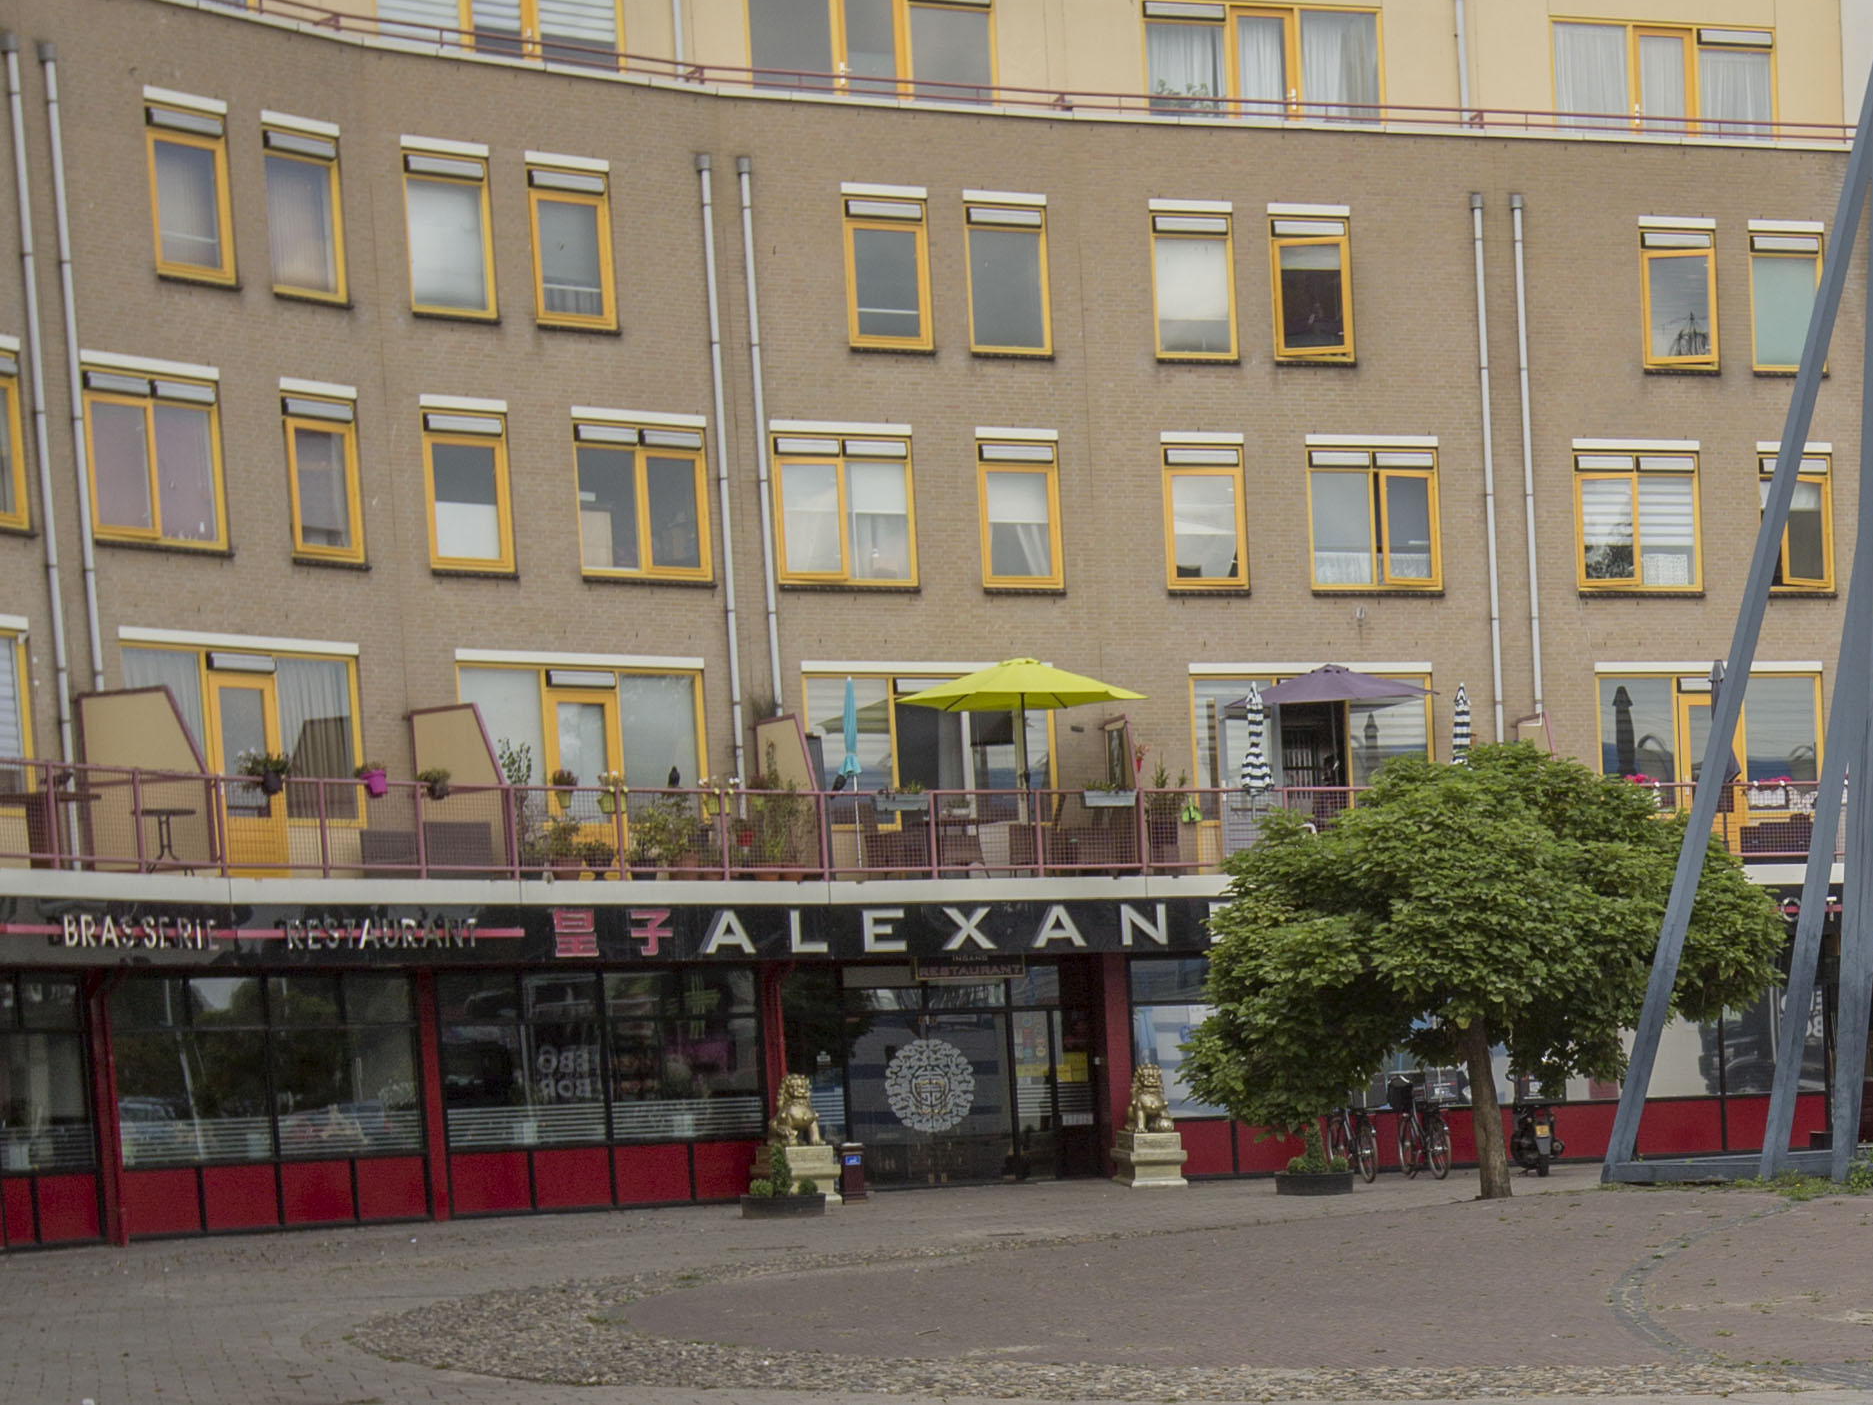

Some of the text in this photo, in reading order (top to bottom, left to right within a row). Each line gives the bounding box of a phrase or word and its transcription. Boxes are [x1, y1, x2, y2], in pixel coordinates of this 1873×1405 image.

[62, 913, 479, 951] BRASSERIE RESTAURANT
[551, 907, 674, 958] 皇子
[918, 964, 1022, 977] RESTAURANT
